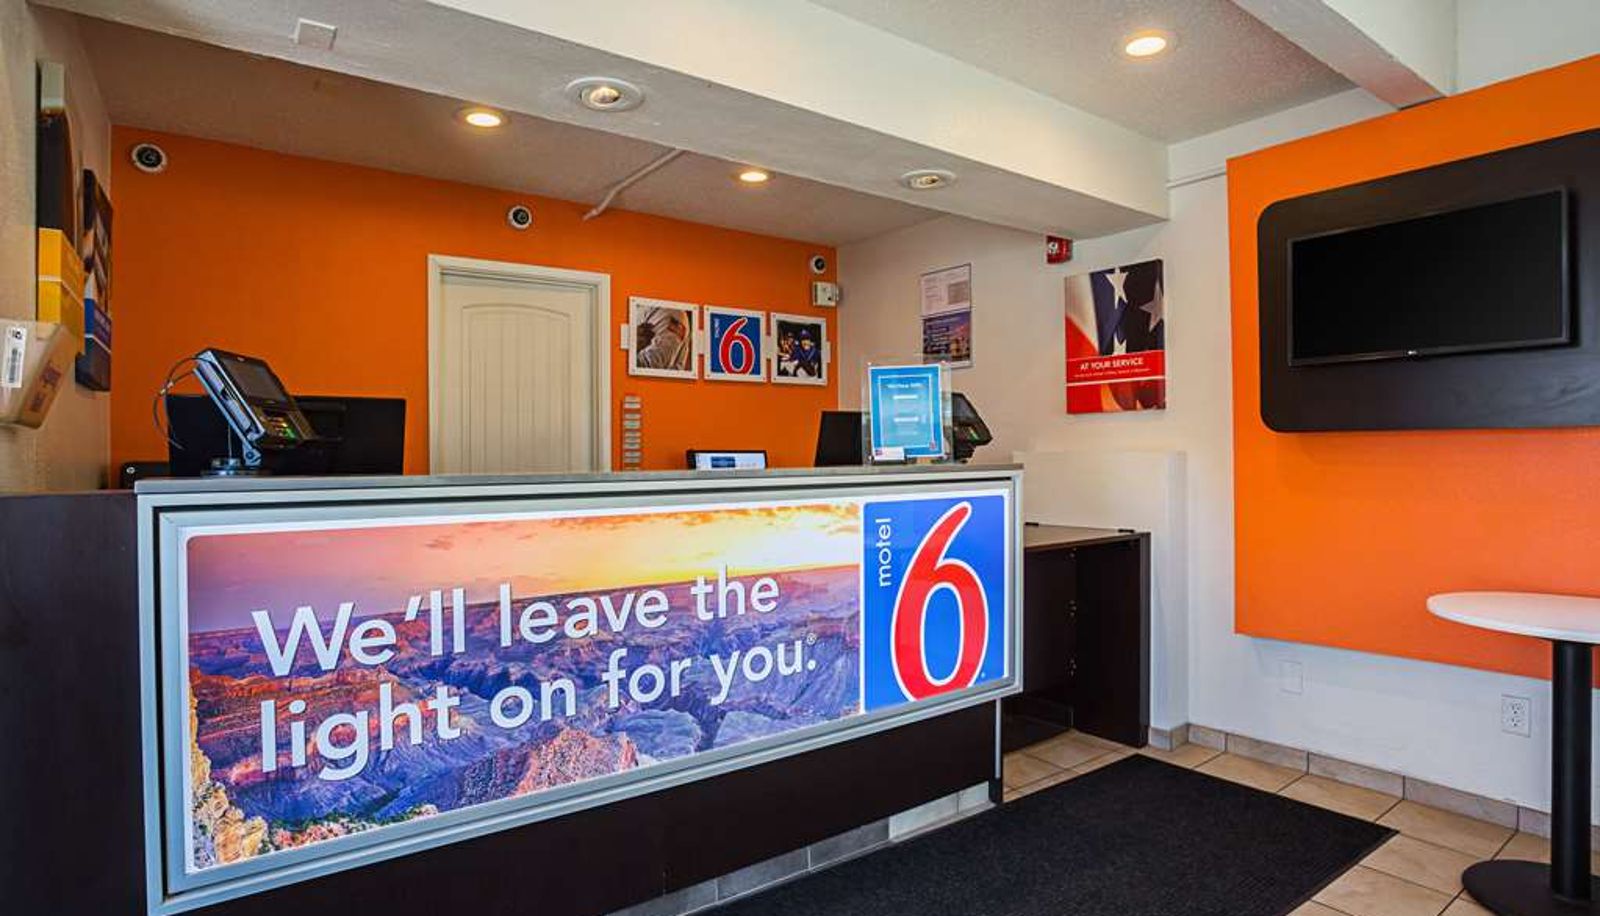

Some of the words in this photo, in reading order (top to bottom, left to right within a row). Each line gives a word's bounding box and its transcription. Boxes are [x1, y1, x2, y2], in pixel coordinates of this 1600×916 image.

[719, 317, 755, 375] 6
[1079, 363, 1089, 371] AT
[1091, 361, 1111, 369] YOUR
[1112, 358, 1143, 367] SERVICE
[875, 517, 893, 587] motel
[251, 586, 465, 677] We'll
[500, 582, 669, 648] leave
[690, 565, 780, 624] the
[891, 501, 990, 702] 6
[260, 682, 461, 782] light
[489, 675, 577, 729] on
[600, 648, 692, 710] for
